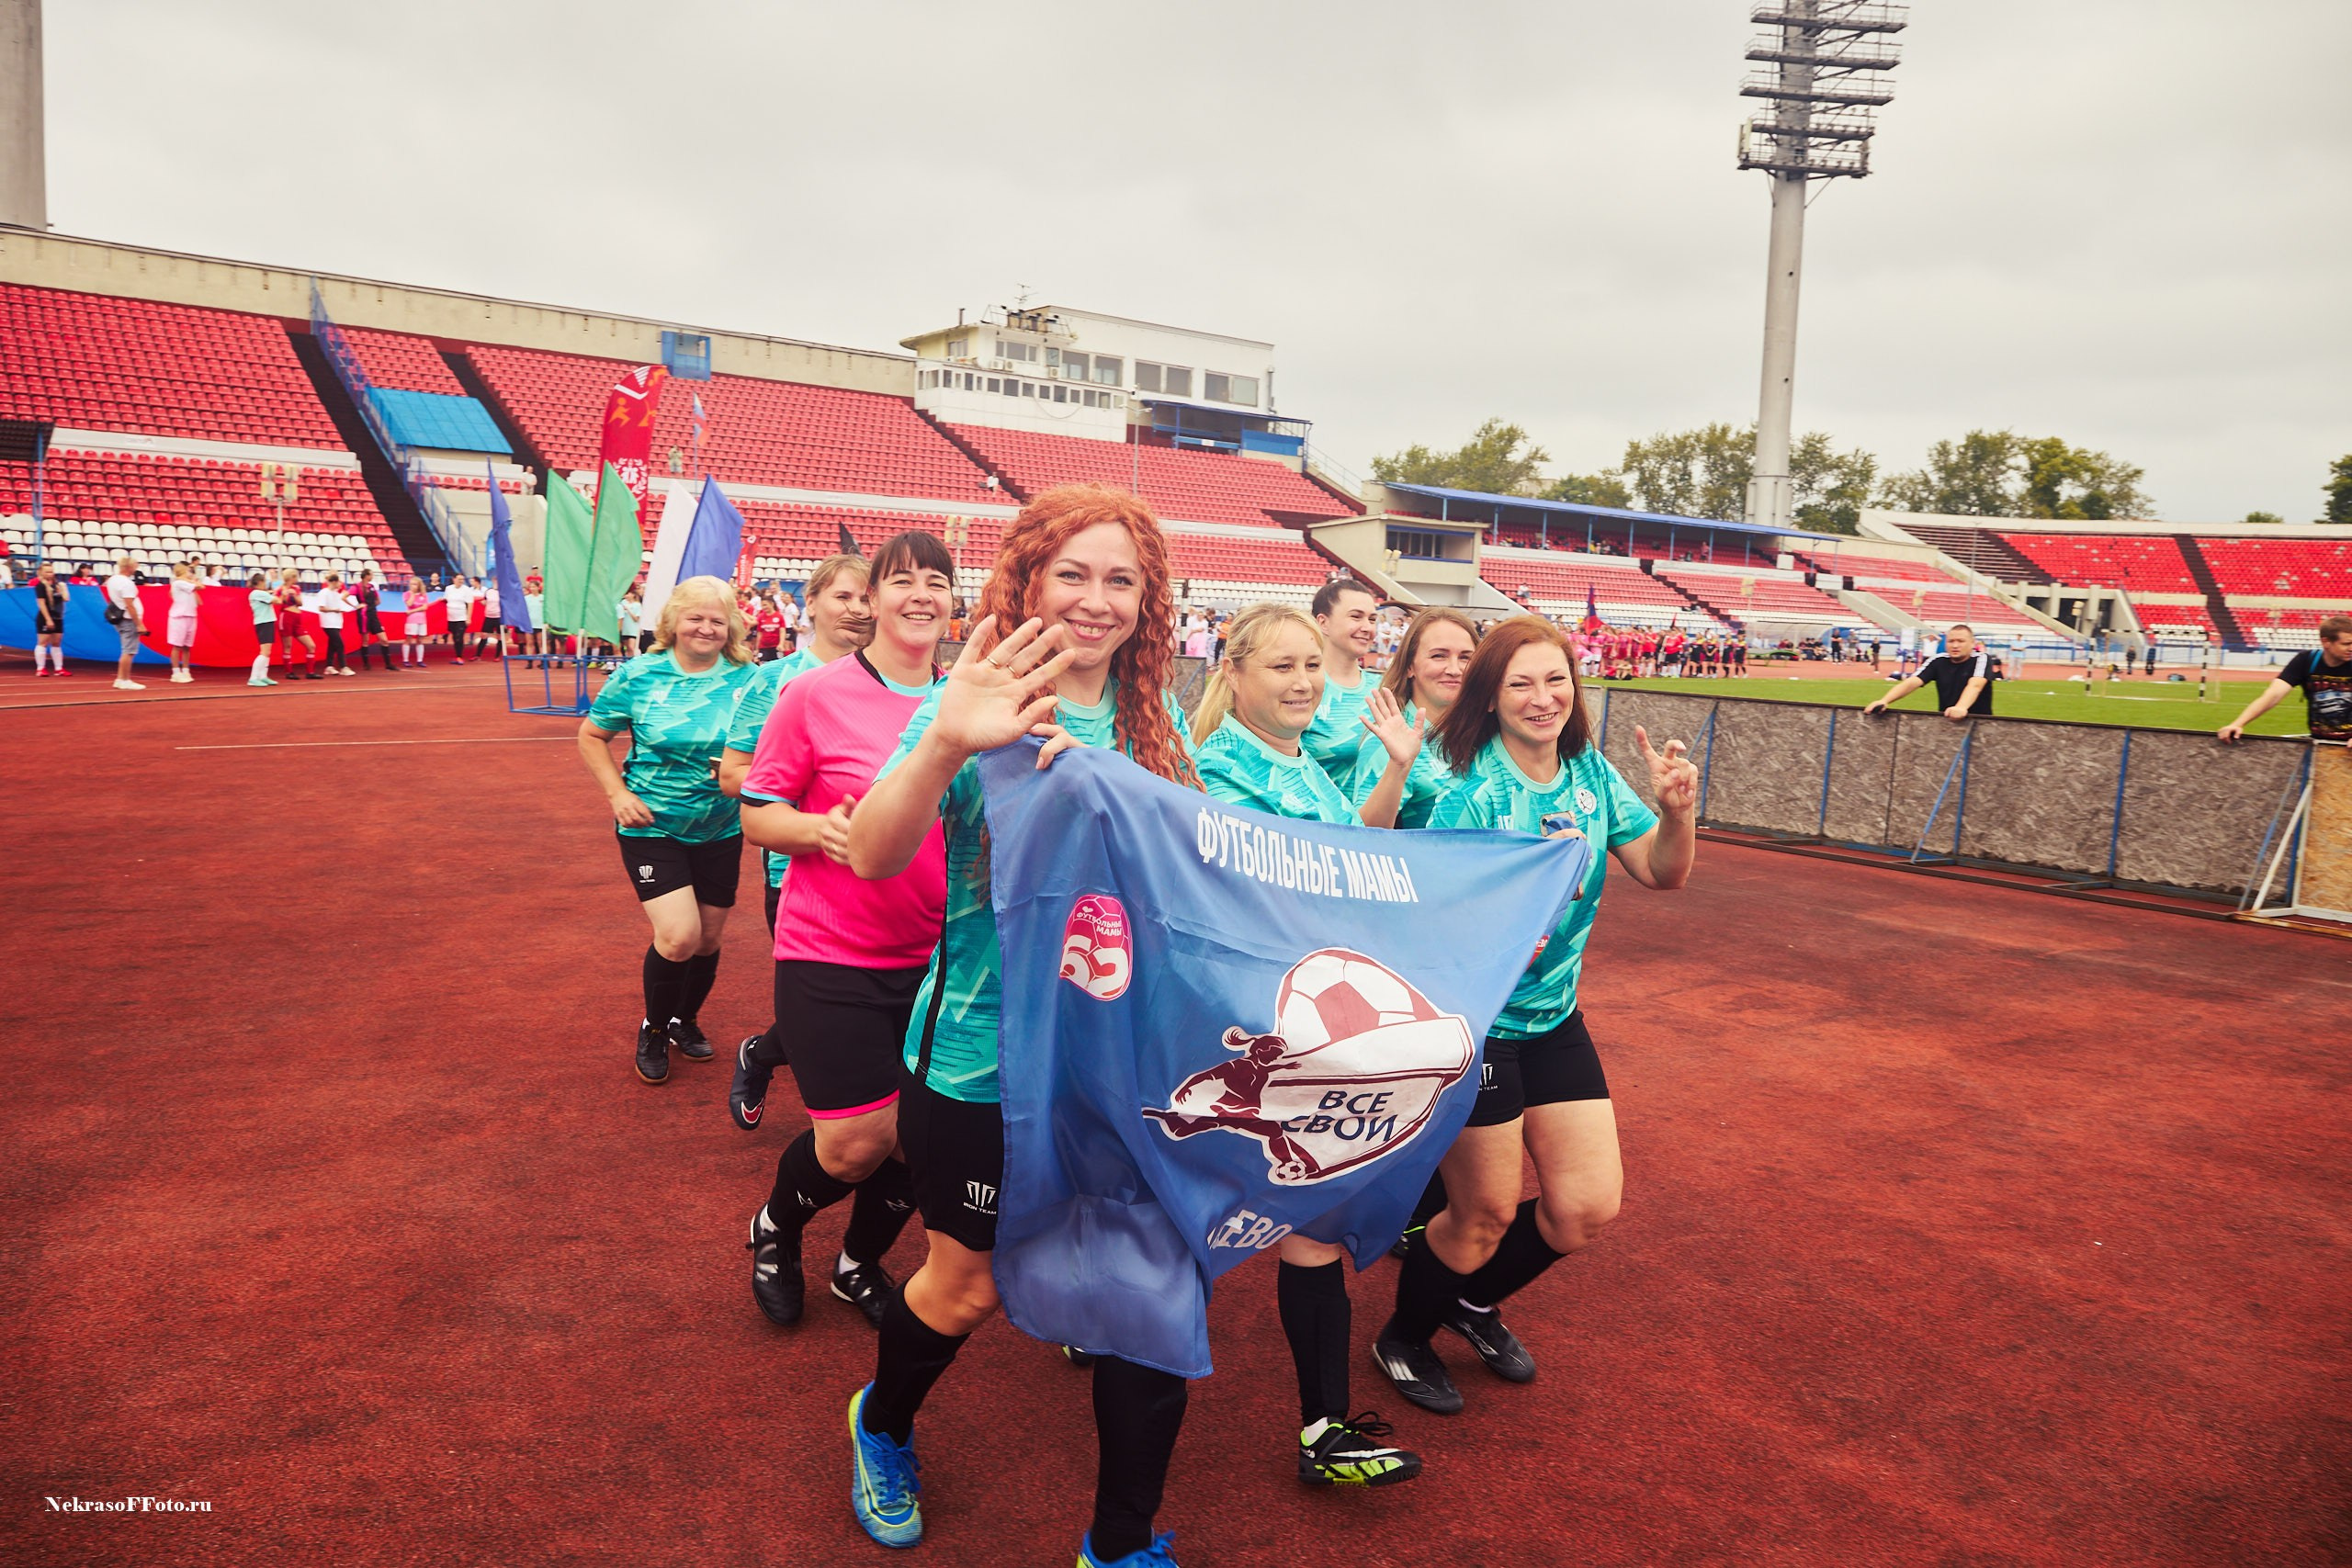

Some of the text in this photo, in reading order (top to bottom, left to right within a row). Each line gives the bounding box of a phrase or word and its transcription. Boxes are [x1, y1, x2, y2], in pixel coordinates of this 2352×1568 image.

[1197, 807, 1419, 903] ФУТБОЛЬНЫЕ МАМЫ
[1096, 925, 1122, 937] МАМЫ
[1318, 1090, 1394, 1114] ВСЕ
[1281, 1114, 1398, 1142] СВОИ
[963, 1201, 978, 1211] IRON
